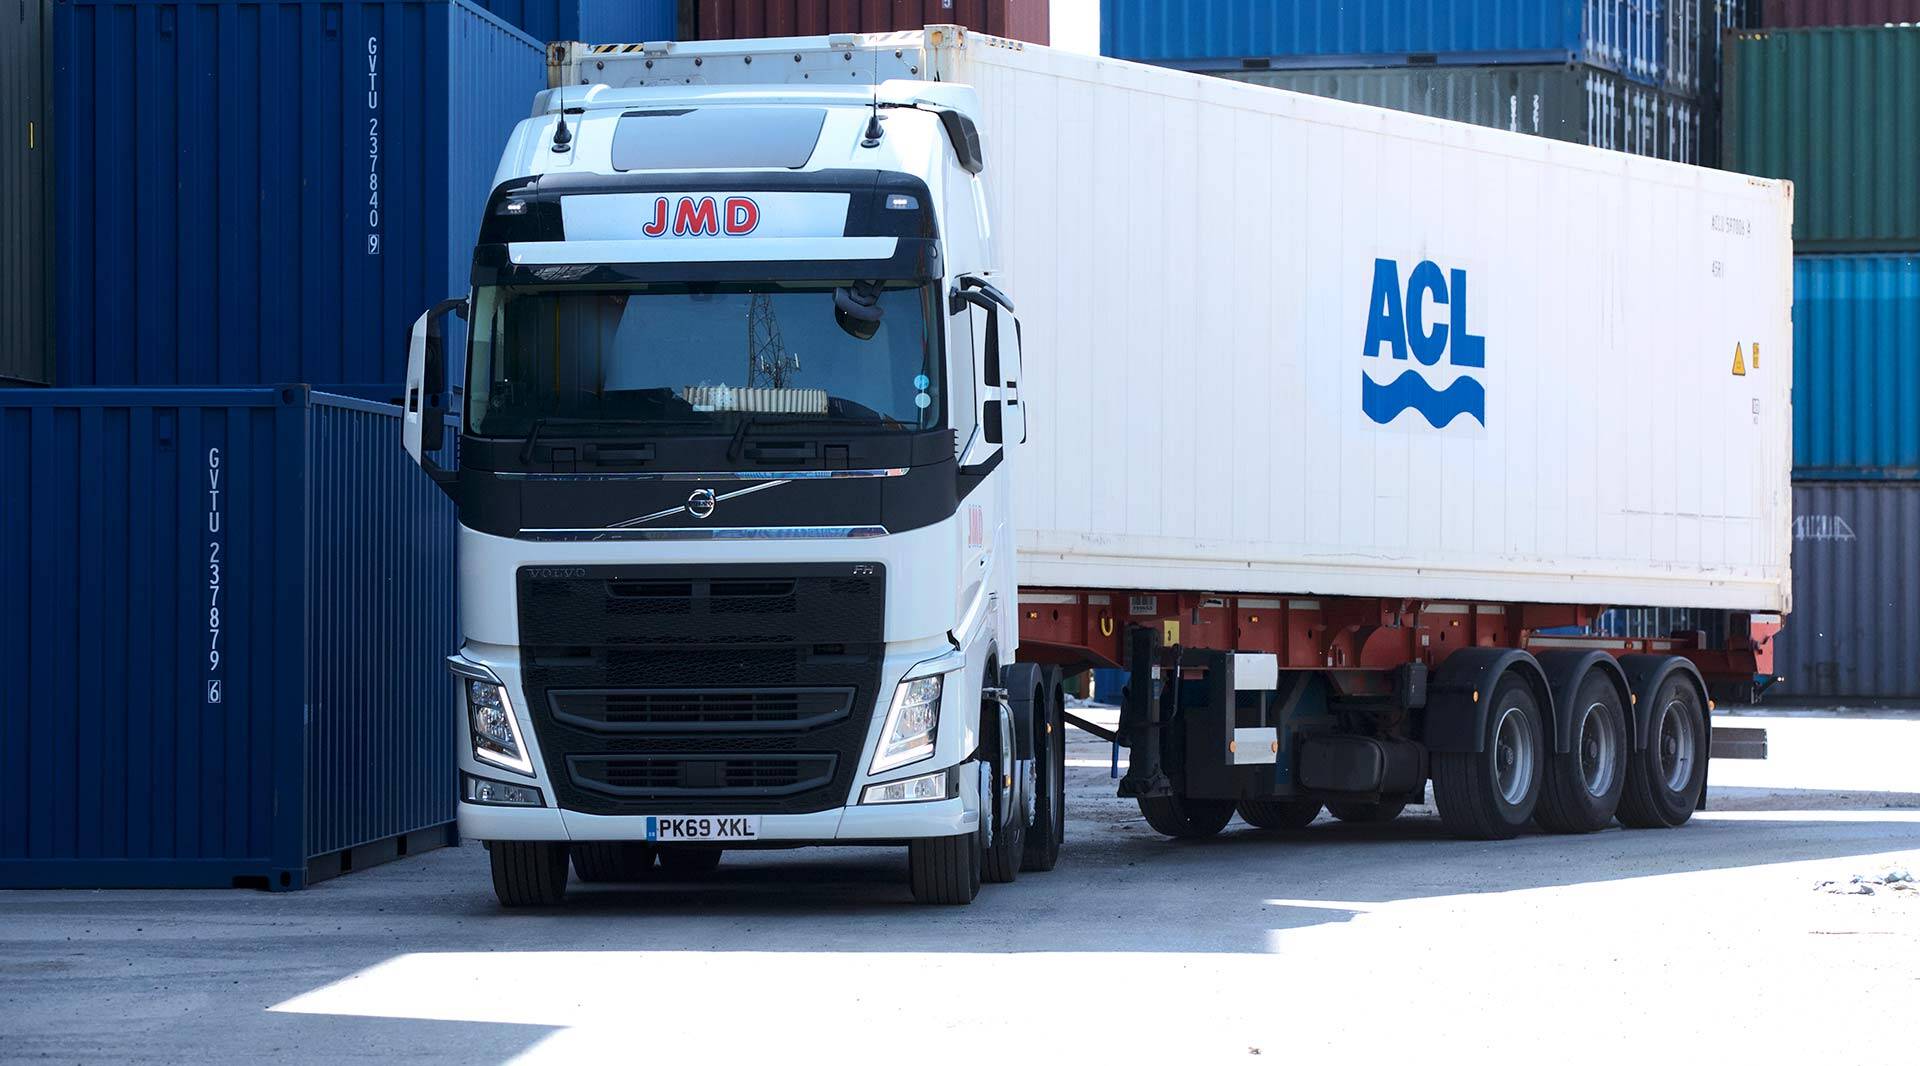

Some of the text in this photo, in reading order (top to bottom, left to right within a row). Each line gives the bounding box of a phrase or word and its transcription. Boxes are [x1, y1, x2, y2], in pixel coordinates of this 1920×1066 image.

[368, 36, 379, 253] GVTU 237840 9
[642, 196, 760, 237] JMD
[1363, 258, 1485, 368] ACL
[209, 447, 220, 702] GVTU 237879 6
[526, 567, 586, 578] VOLVO
[660, 818, 755, 837] PK69 XKL
